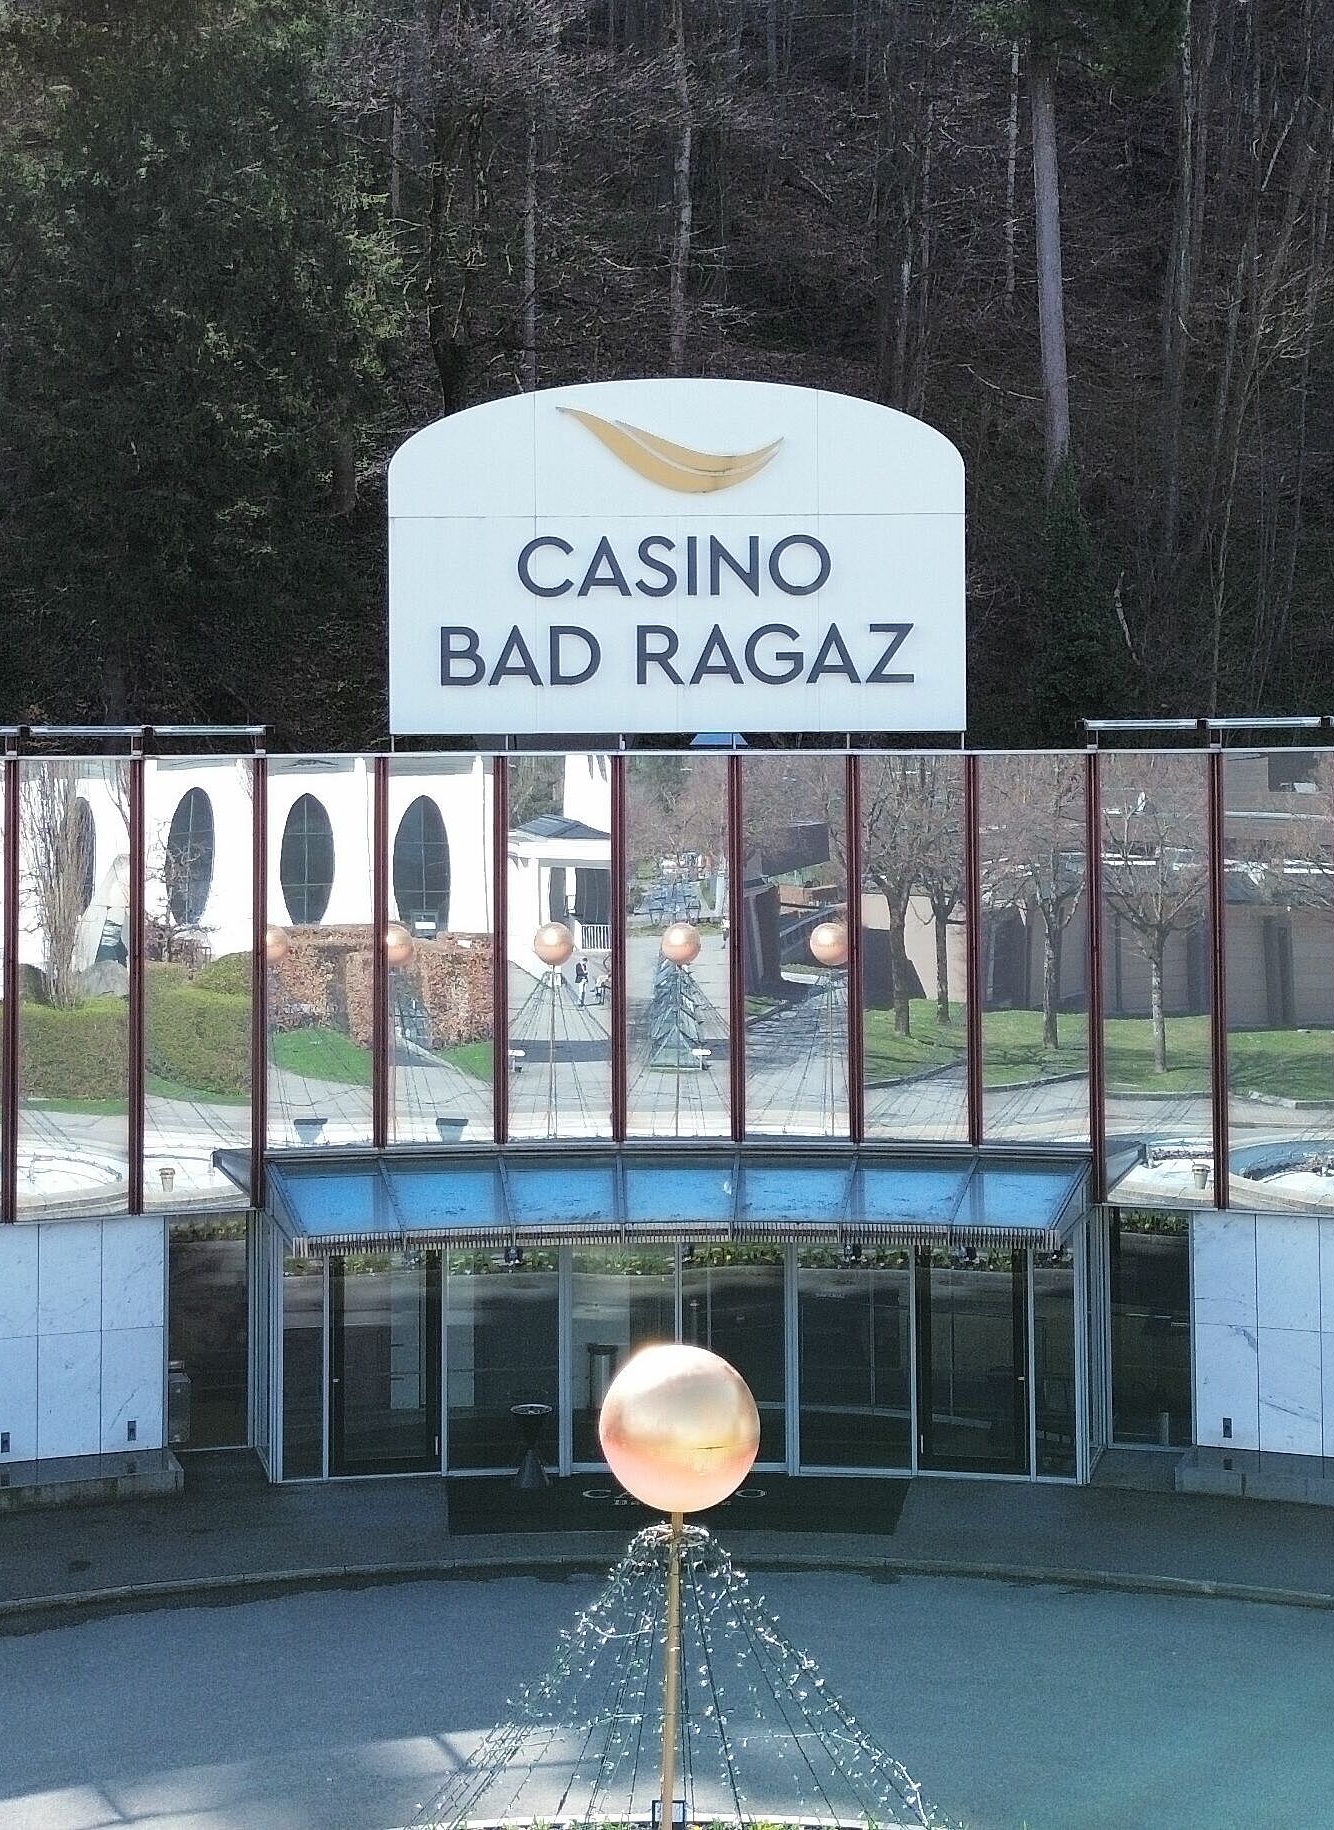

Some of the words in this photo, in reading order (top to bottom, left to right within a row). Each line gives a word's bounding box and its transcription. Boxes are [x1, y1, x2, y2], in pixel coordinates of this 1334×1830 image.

[517, 534, 832, 598] CASINO
[440, 624, 602, 687] BAD
[636, 622, 915, 686] RAGAZ
